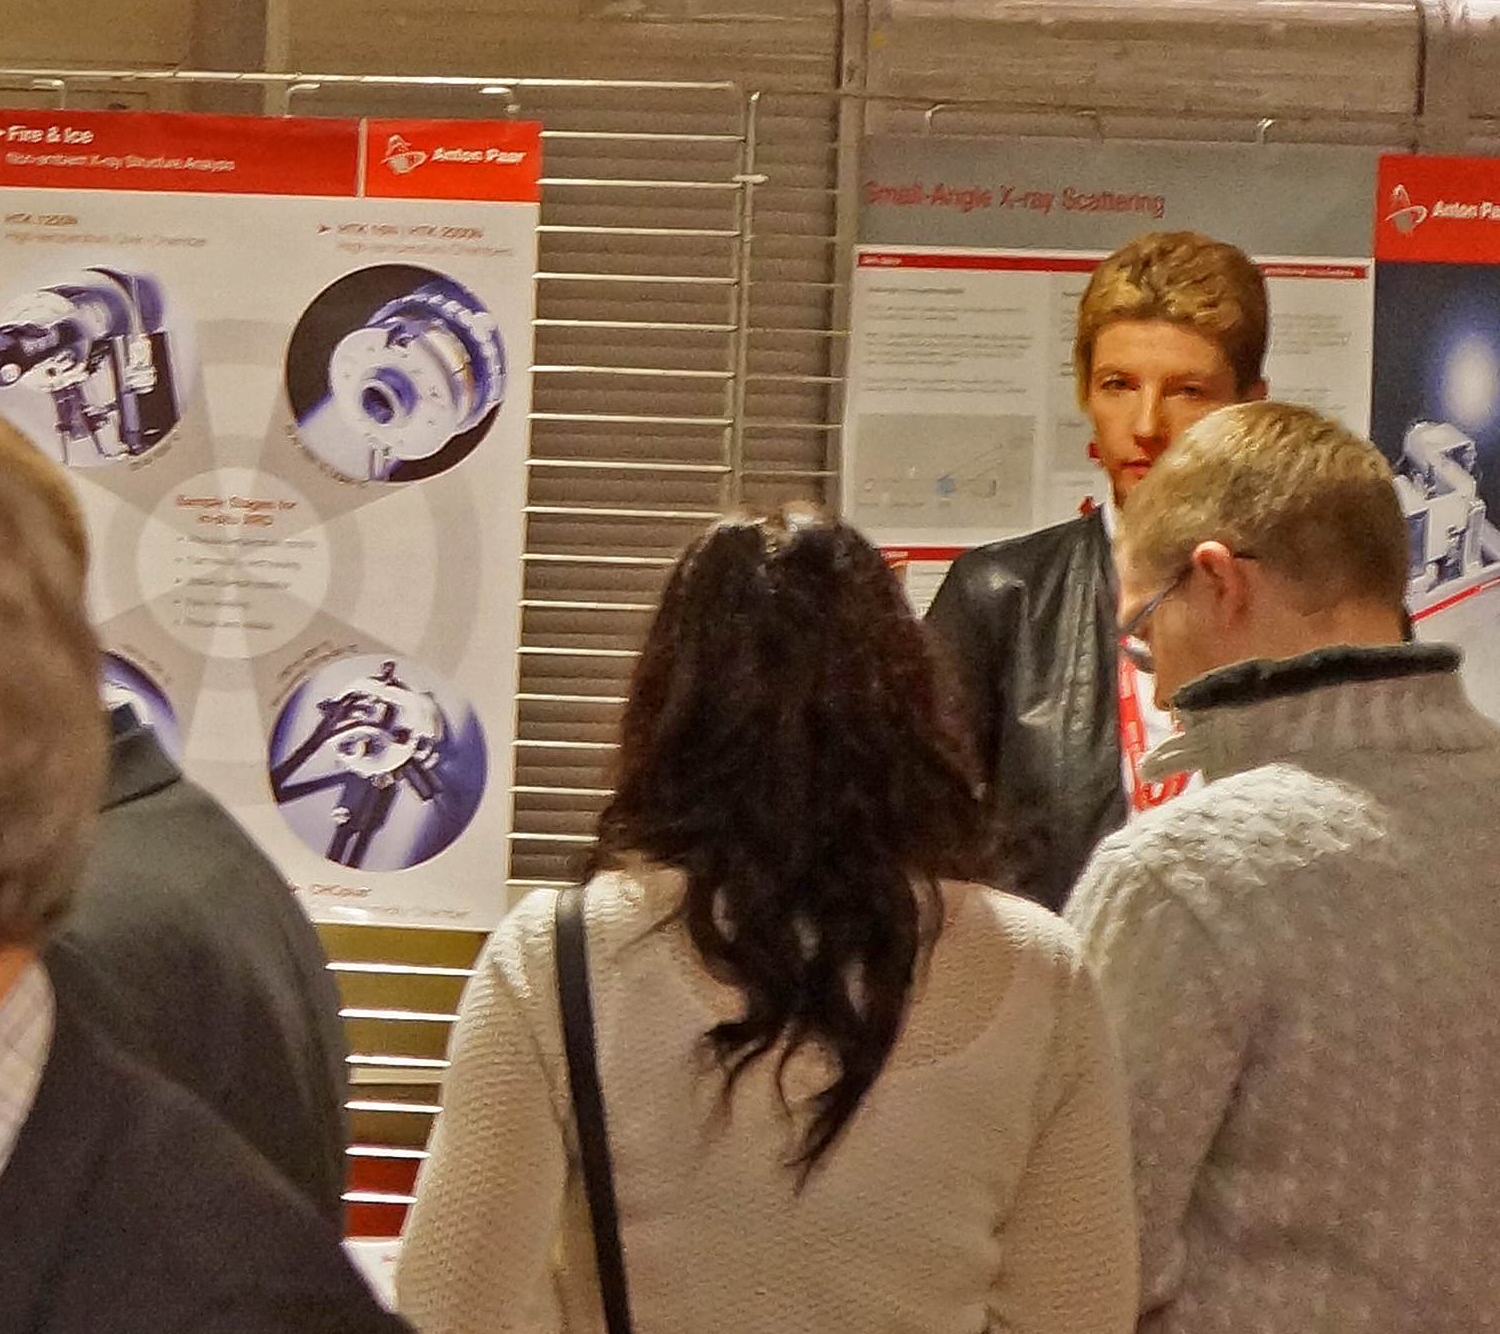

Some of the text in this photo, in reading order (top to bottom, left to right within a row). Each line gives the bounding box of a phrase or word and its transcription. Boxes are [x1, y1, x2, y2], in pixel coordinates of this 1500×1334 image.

[63, 127, 94, 145] Ice
[999, 185, 1055, 214] X-ray
[1062, 186, 1166, 219] Scattering
